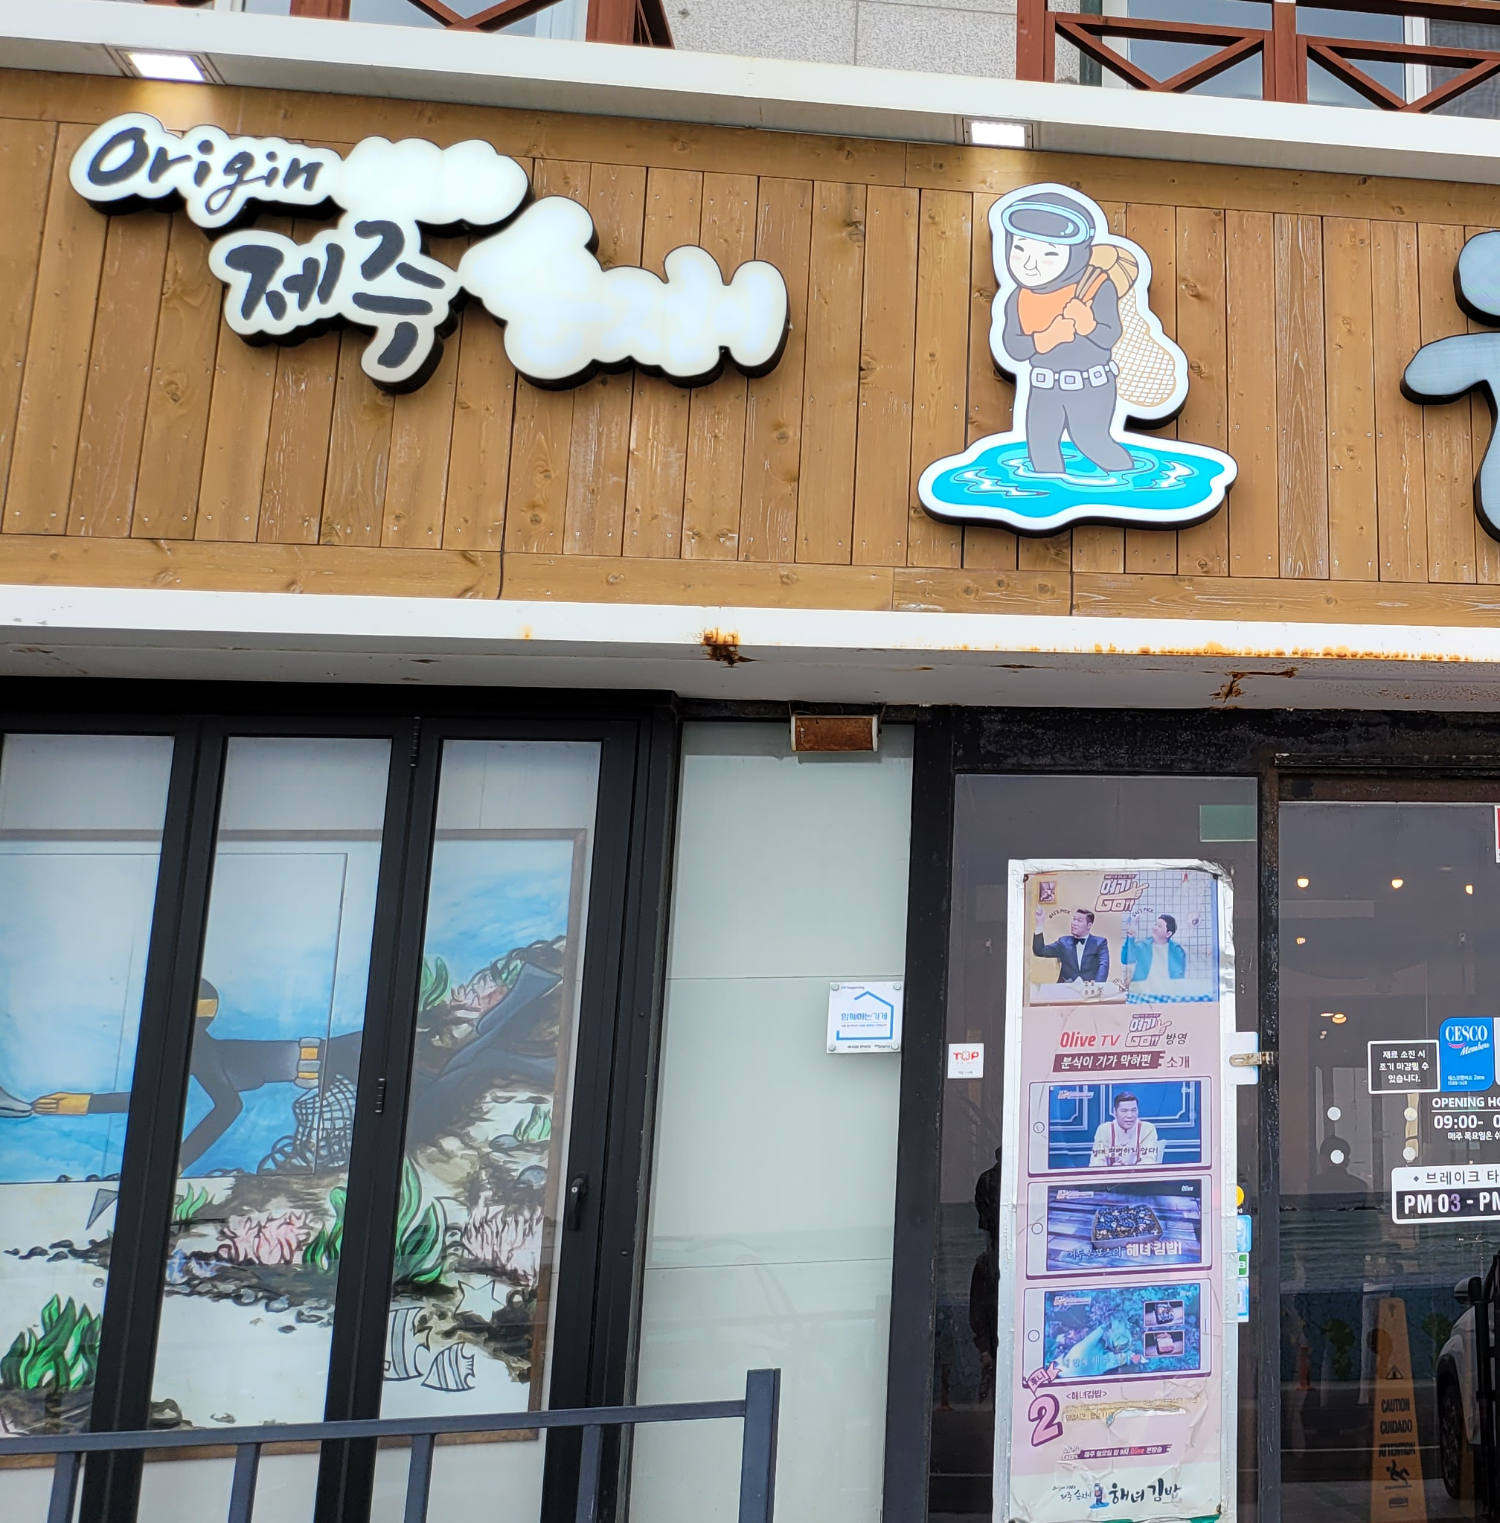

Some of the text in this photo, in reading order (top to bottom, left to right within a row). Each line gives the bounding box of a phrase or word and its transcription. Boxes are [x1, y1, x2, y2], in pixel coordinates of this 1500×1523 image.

[86, 126, 325, 215] Origin
[225, 219, 446, 370] 제주
[1060, 1031, 1121, 1048] Olive TV
[1166, 1032, 1188, 1046] 방영
[1445, 1025, 1488, 1042] CESCO
[1061, 1056, 1094, 1069] 분식이
[1096, 1055, 1118, 1068] 기가
[1167, 1055, 1190, 1068] 소개
[1382, 1050, 1426, 1059] 재료 소진 시
[1379, 1061, 1430, 1071] 조기 마감될 수
[1388, 1074, 1421, 1084] 있습니다.
[1432, 1097, 1485, 1108] OPENING
[1447, 1131, 1463, 1141] 매주
[1464, 1131, 1493, 1141] 목요일은
[1425, 1170, 1480, 1185] 브레이크
[1404, 1194, 1433, 1215] PM
[1437, 1193, 1461, 1213] 03
[1030, 1371, 1047, 1386] 후니
[1381, 1397, 1410, 1413] CAUTION
[1028, 1393, 1063, 1446] 2
[1380, 1419, 1413, 1434] CUIDADO
[1378, 1442, 1416, 1457] ATTENTION
